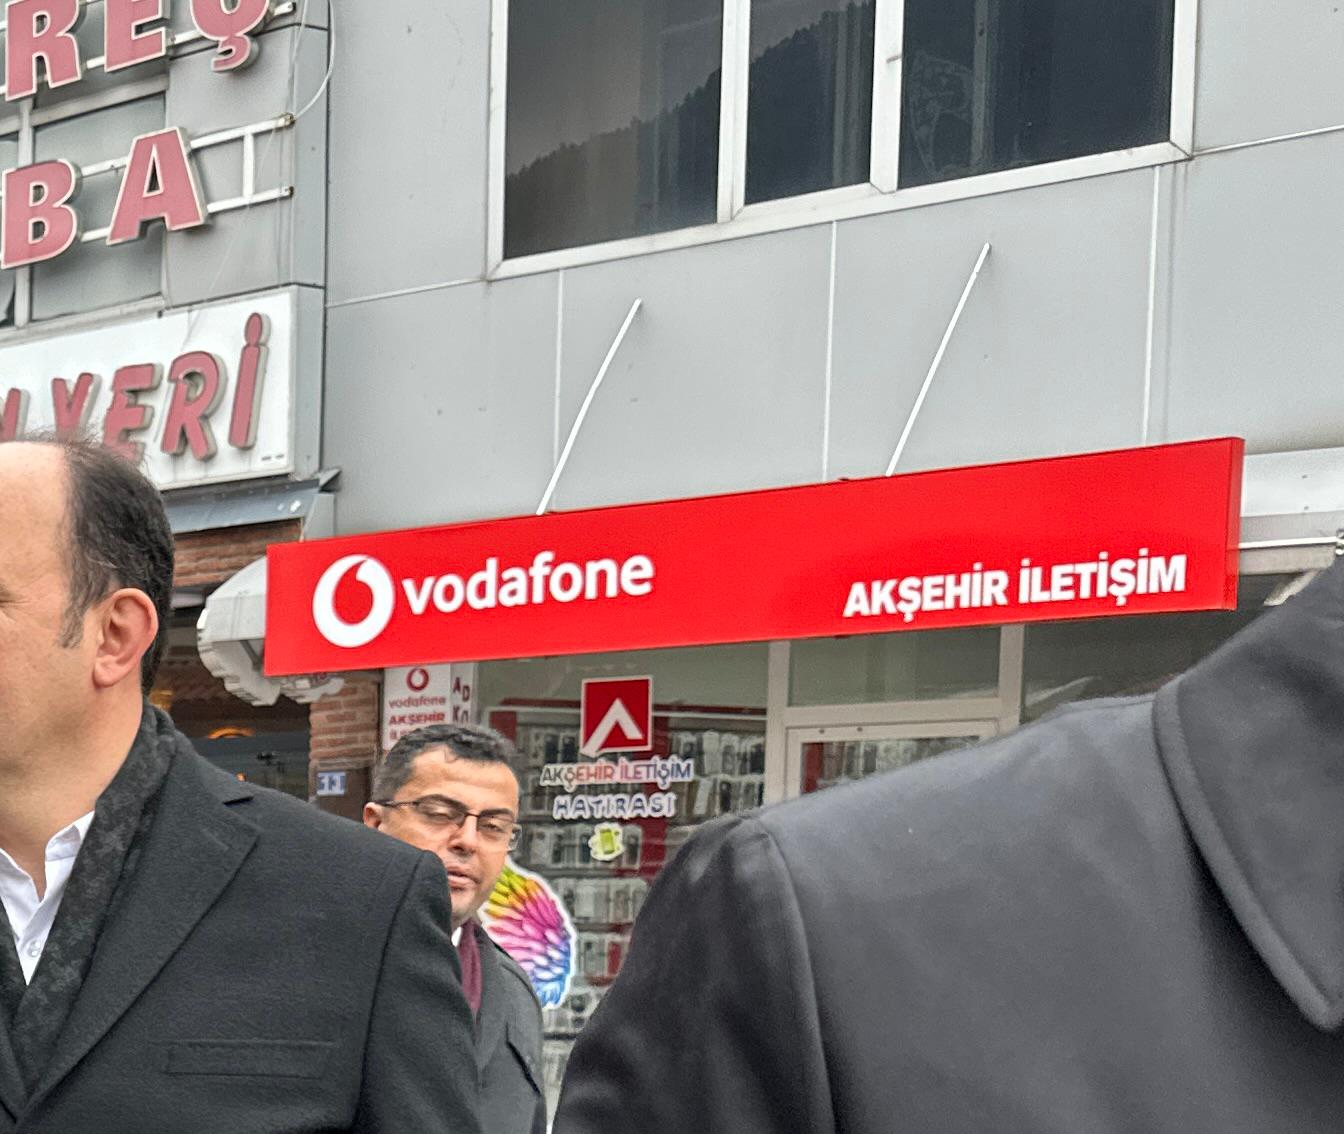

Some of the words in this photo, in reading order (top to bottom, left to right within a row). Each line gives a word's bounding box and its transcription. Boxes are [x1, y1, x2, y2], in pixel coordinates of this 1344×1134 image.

[402, 550, 655, 616] vodafone
[842, 561, 1010, 624] AKŞEHİR
[1018, 547, 1188, 608] İLETİŞİM
[541, 758, 616, 791] AKŞEHİR
[619, 756, 693, 787] İLETİŞİM
[554, 794, 675, 819] HATIRASI
